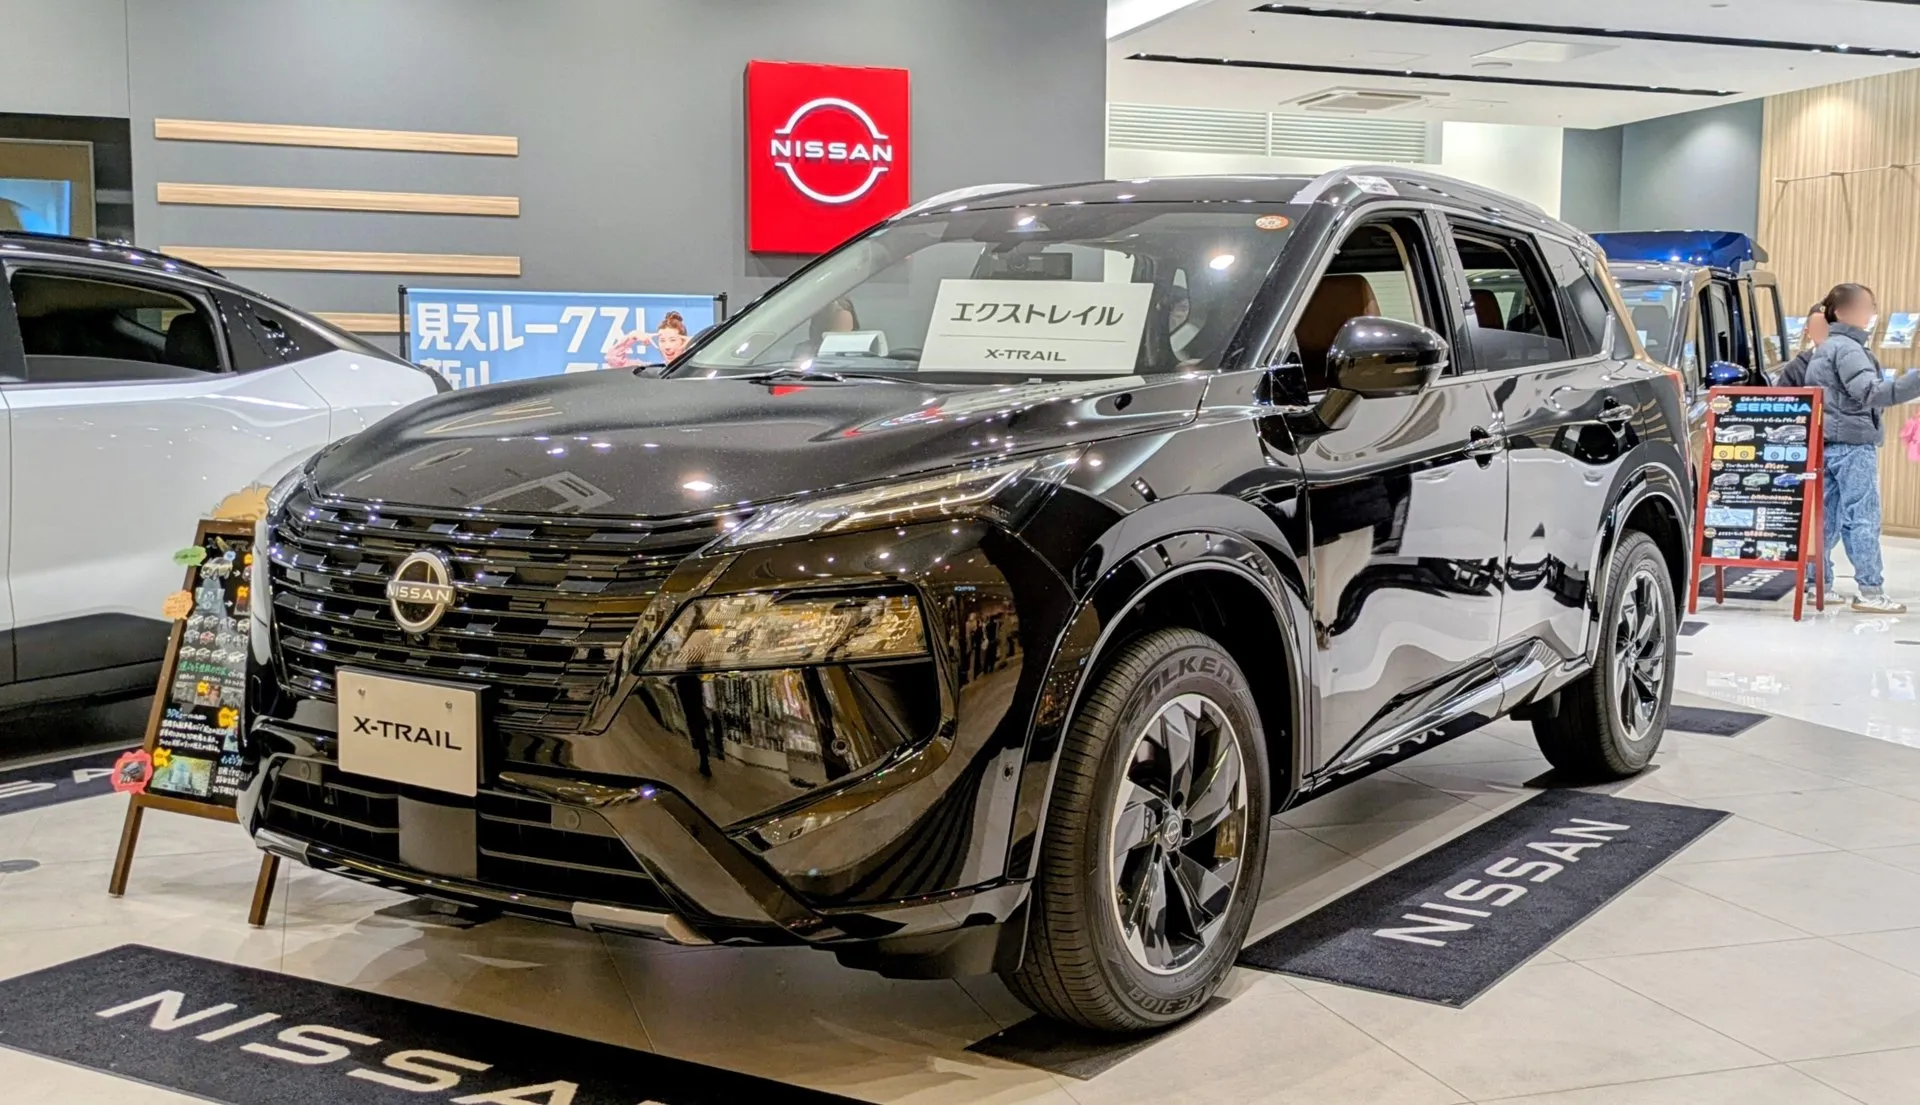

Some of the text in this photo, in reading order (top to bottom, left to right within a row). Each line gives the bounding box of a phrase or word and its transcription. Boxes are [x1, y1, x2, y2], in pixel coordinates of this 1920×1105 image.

[770, 139, 893, 162] NISSAN
[950, 302, 1124, 326] エクストレイル
[984, 349, 1067, 362] X-TRAIL
[1735, 402, 1812, 413] SERENA
[387, 585, 451, 602] NISSAN
[353, 715, 463, 751] X-TRAIL
[1372, 817, 1632, 948] NISSAN
[96, 989, 669, 1105] NISSA
